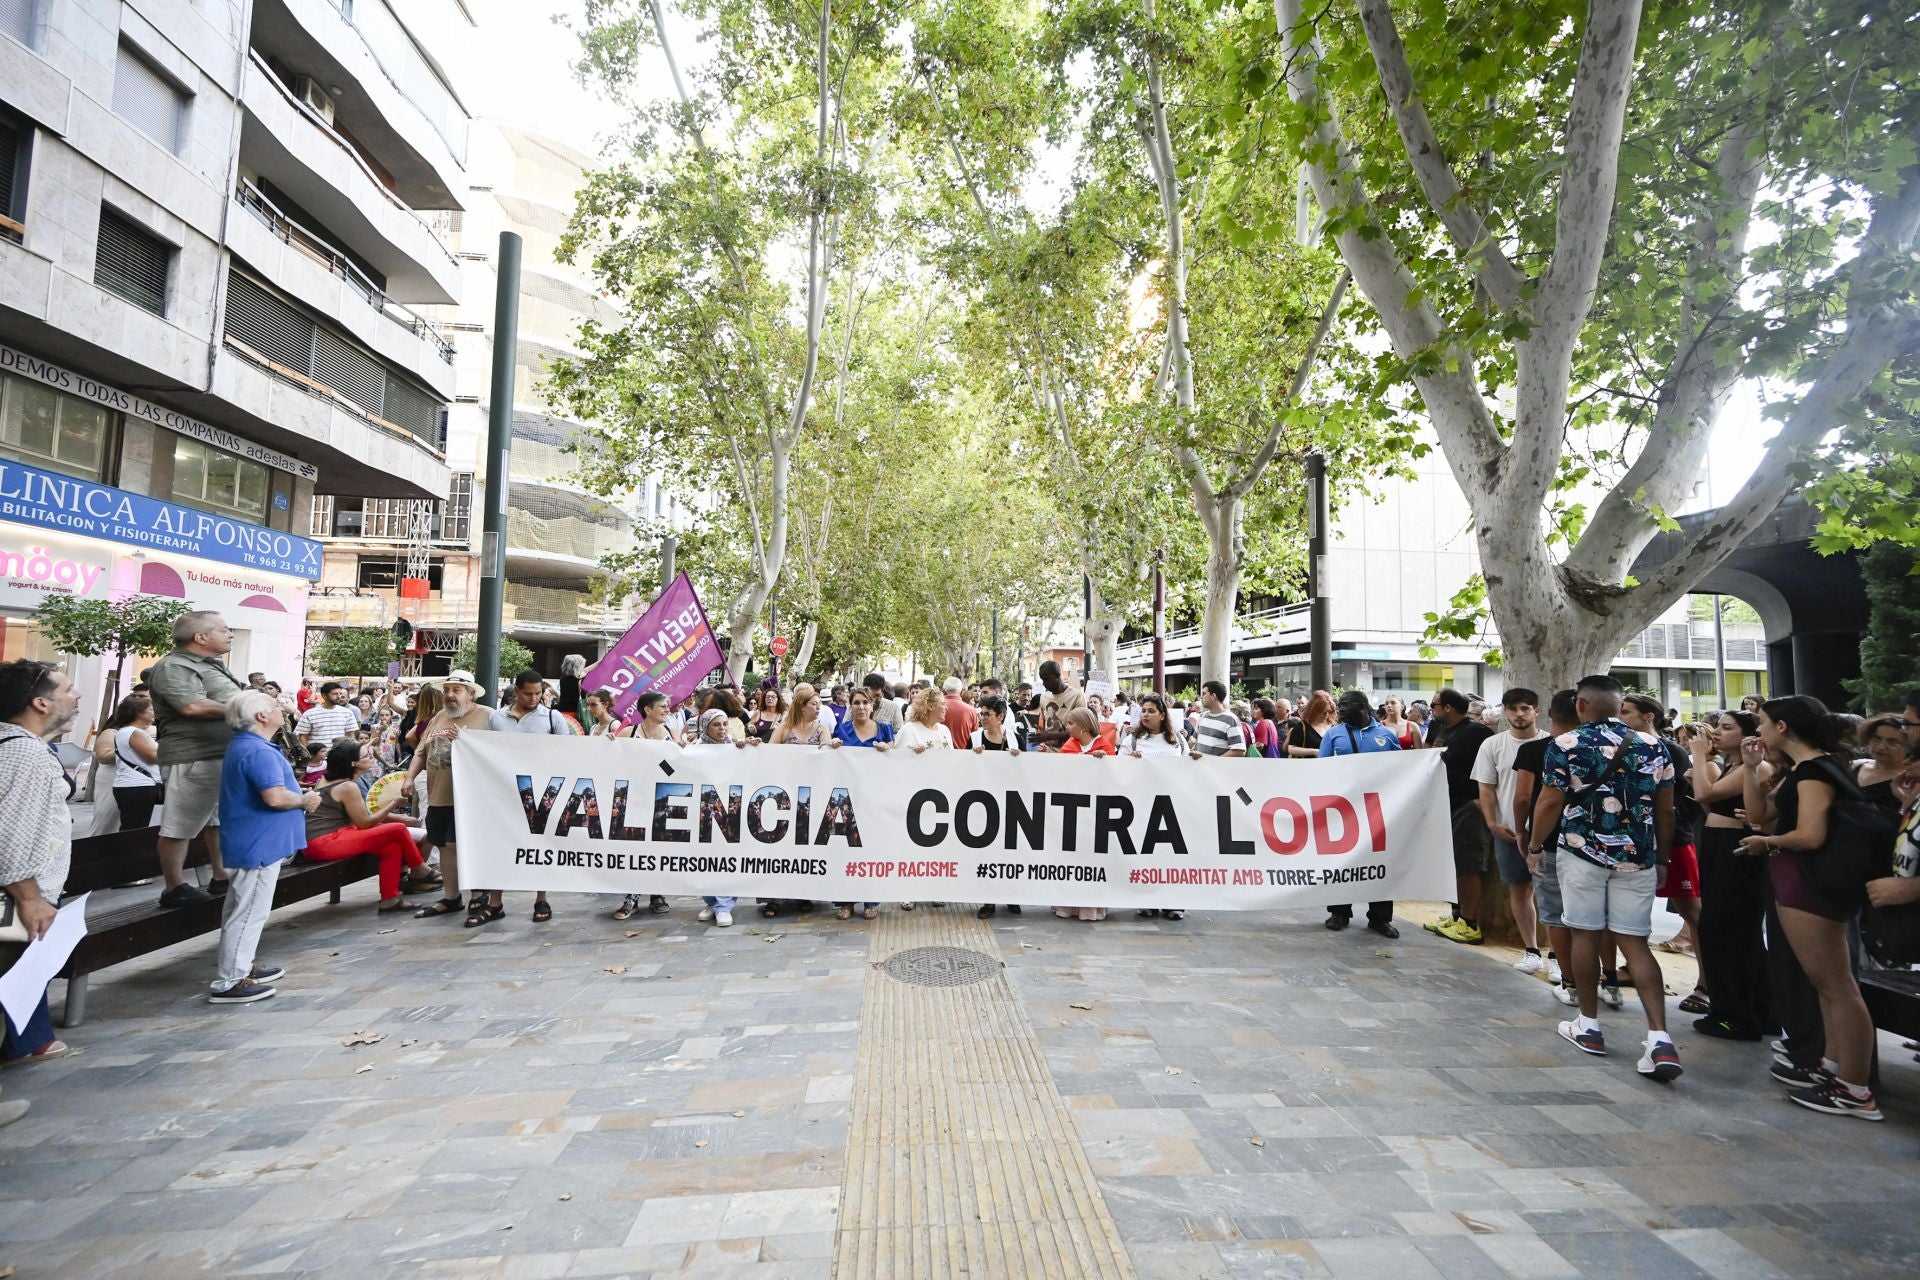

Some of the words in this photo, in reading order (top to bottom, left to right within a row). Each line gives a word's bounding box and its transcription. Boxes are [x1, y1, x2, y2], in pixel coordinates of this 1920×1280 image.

[76, 376, 129, 410] TODAS
[134, 400, 161, 422] LAS
[246, 445, 296, 473] adeslas
[0, 502, 95, 531] BILITACION
[100, 522, 110, 534] Y
[114, 525, 201, 553] FISIOTERAPIA
[151, 506, 292, 558] ALFONSO
[300, 541, 319, 565] X
[259, 554, 278, 569] 968
[279, 560, 291, 570] 23
[294, 564, 305, 574] 93
[307, 567, 319, 577] 96
[8, 580, 33, 590] yogurt
[33, 582, 39, 590] &
[40, 584, 51, 592] ice
[186, 570, 198, 581] Tu
[200, 573, 221, 586] lado
[223, 578, 243, 592] más
[244, 583, 274, 594] natural
[515, 759, 863, 848] VALÈNCIA
[906, 788, 1189, 855] CONTRA
[515, 848, 554, 866] PELS
[556, 850, 603, 869] DRETS
[607, 853, 627, 870] DE
[629, 854, 656, 871] LES
[660, 855, 737, 873] PERSONAS
[740, 857, 828, 876] IMMIGRADES
[845, 861, 894, 878] #STOP
[897, 861, 959, 878] RACISME
[976, 863, 1025, 880] #STOP
[1028, 864, 1107, 883] MOROFOBIA
[1129, 868, 1228, 886] #SOLIDARITAT
[1232, 868, 1264, 885] AMB
[1266, 864, 1386, 886] TORRE-PACHECO
